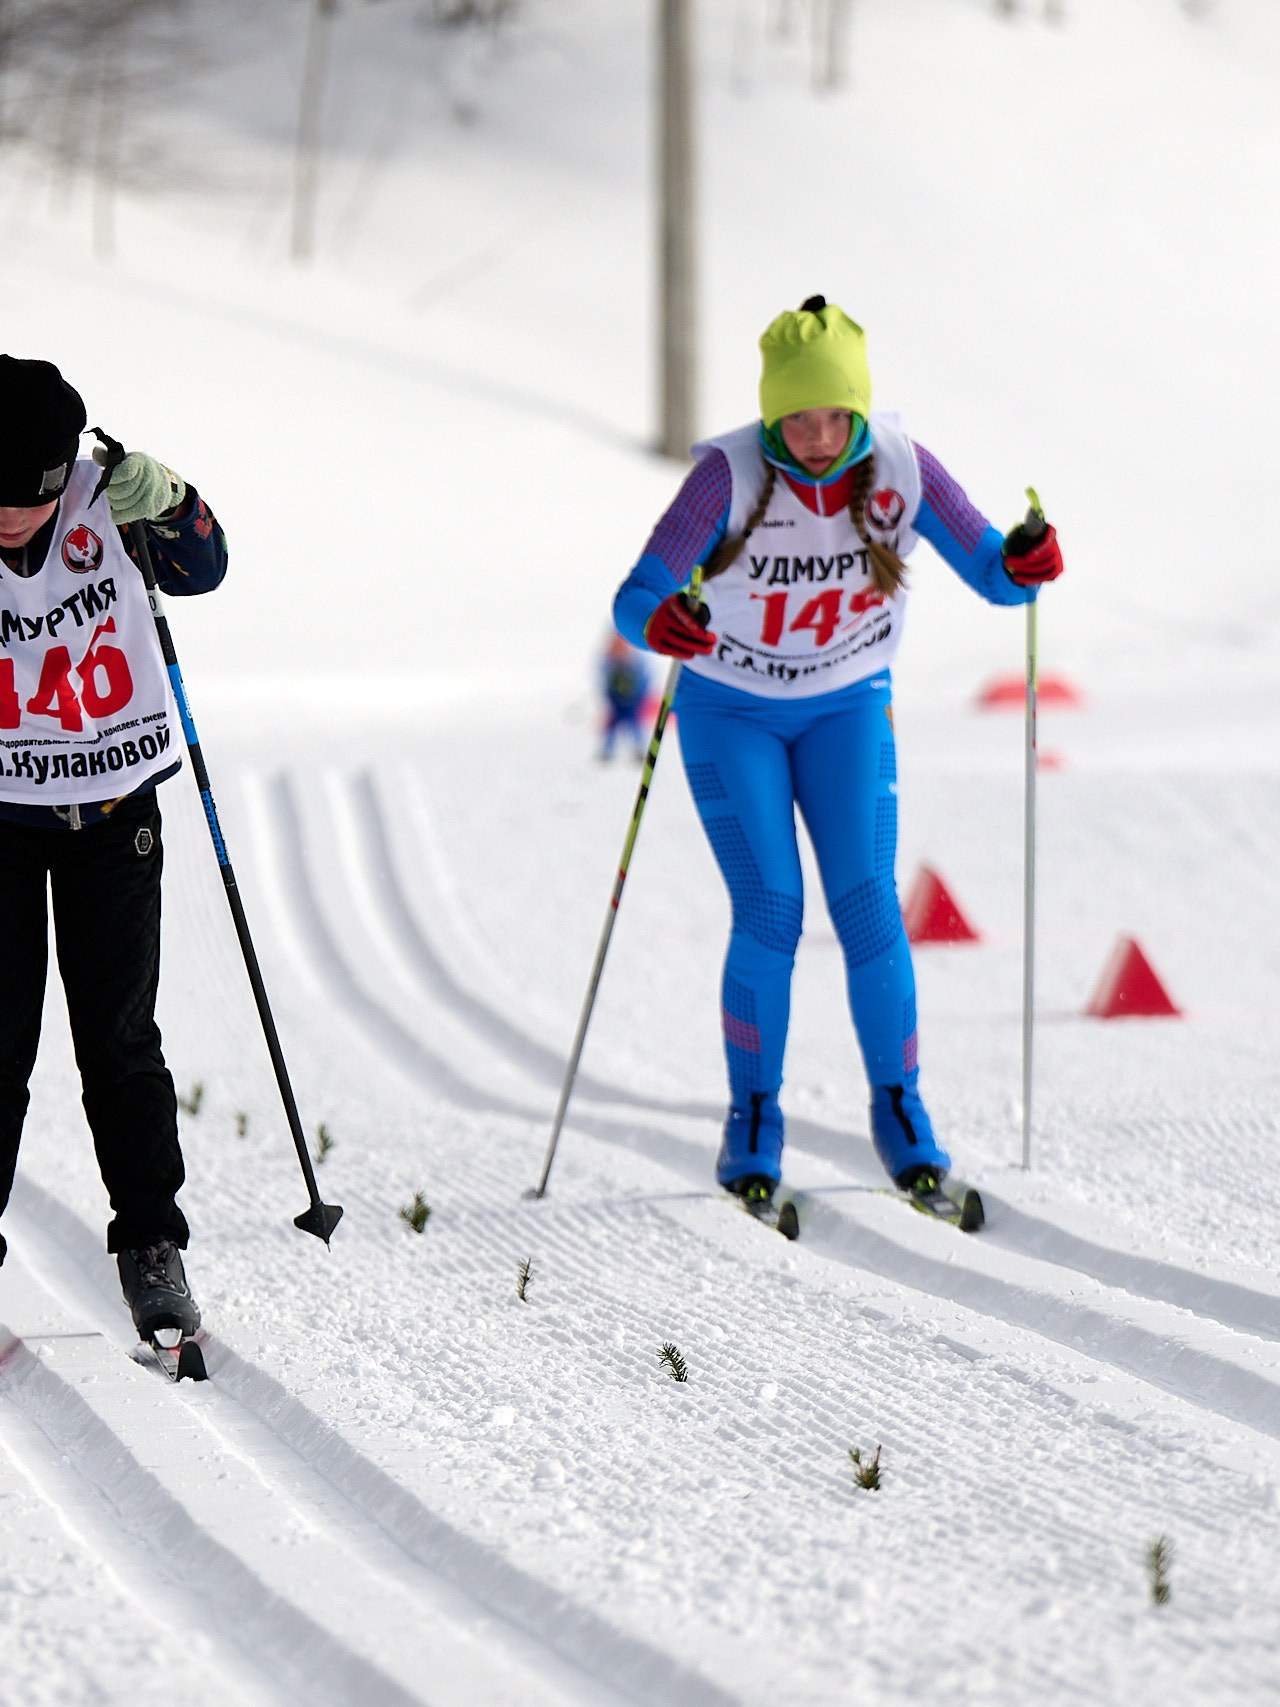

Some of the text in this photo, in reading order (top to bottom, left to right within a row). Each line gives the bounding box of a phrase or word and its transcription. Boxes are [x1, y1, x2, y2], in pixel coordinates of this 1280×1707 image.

[748, 548, 870, 586] УДМУРТ
[104, 718, 140, 737] комплекс
[142, 711, 168, 725] имени
